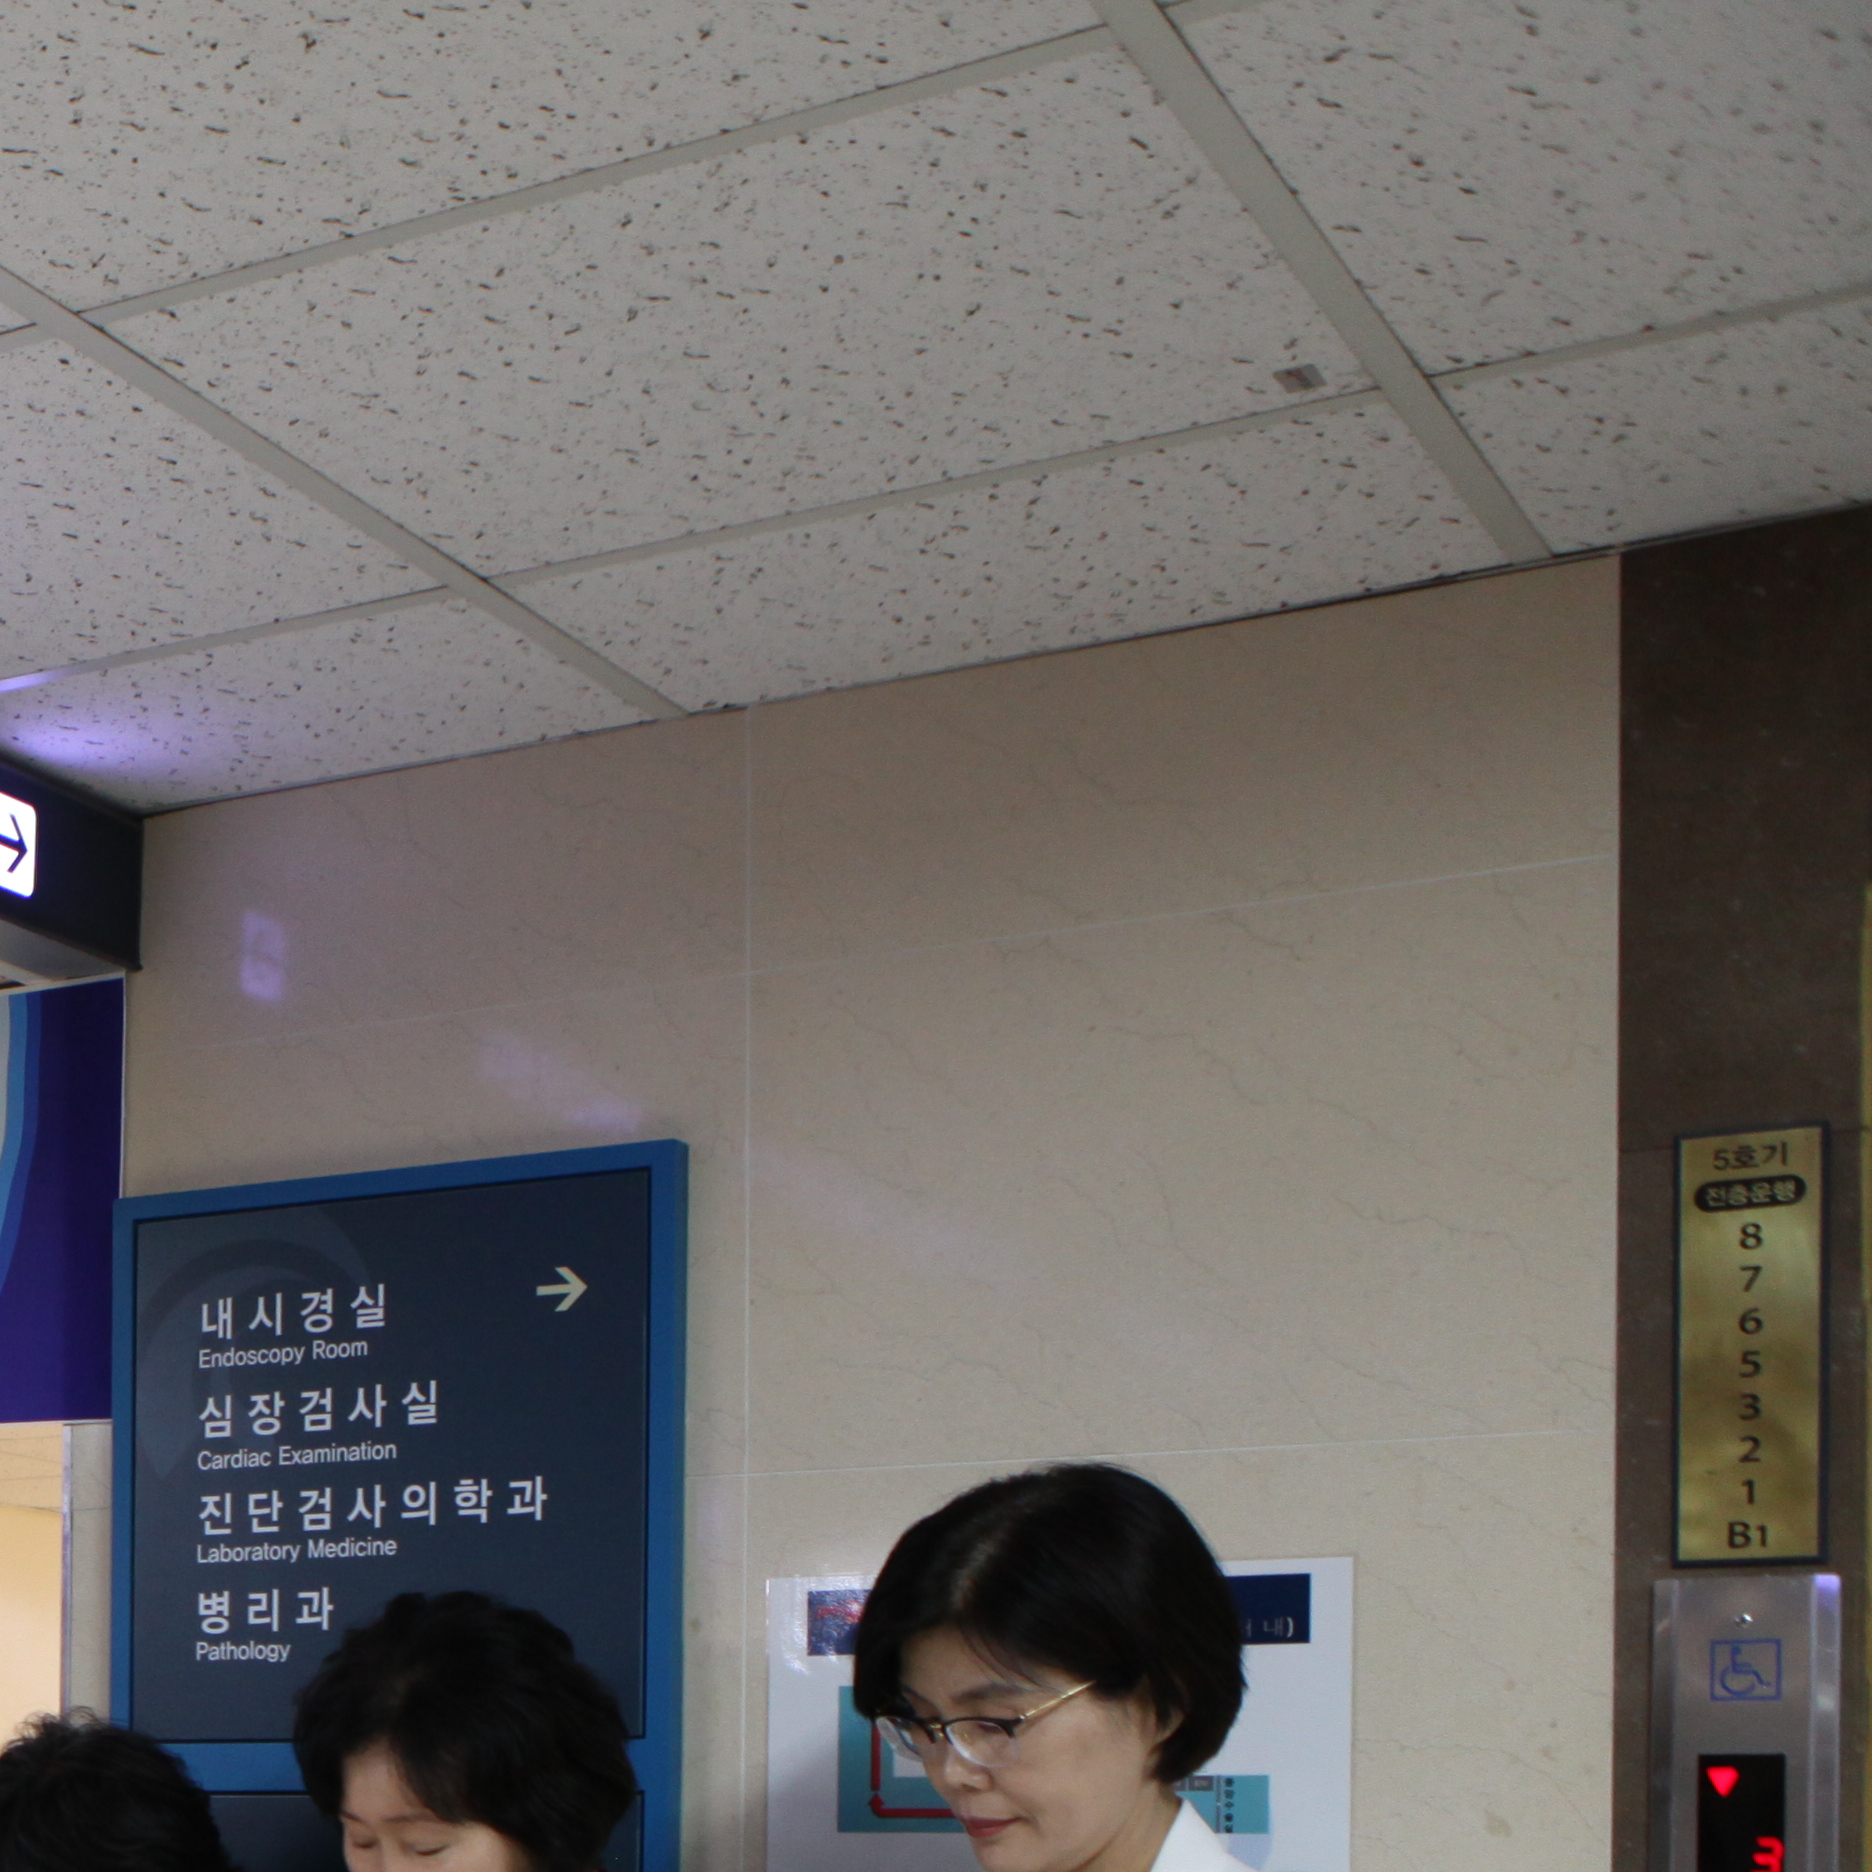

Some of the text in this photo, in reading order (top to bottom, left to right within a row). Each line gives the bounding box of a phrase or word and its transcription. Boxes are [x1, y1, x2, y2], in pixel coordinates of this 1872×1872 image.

[1739, 1222, 1763, 1250] 8
[1739, 1266, 1763, 1293] 7
[201, 1282, 387, 1341] 내시경실
[1738, 1306, 1763, 1335] 6
[198, 1339, 369, 1370] Endoscopy Room
[1739, 1350, 1762, 1379] 5
[198, 1379, 440, 1439] 심장검사실
[1738, 1393, 1762, 1421] 3
[197, 1441, 397, 1471] Cardiac Examination
[1738, 1436, 1762, 1463] 2
[198, 1475, 548, 1537] 진단검사의학과
[1742, 1479, 1756, 1505] 1
[1727, 1521, 1770, 1549] B1
[197, 1536, 398, 1565] Laboratory Medicine
[197, 1586, 335, 1635] 병리과
[196, 1640, 291, 1663] Pathology
